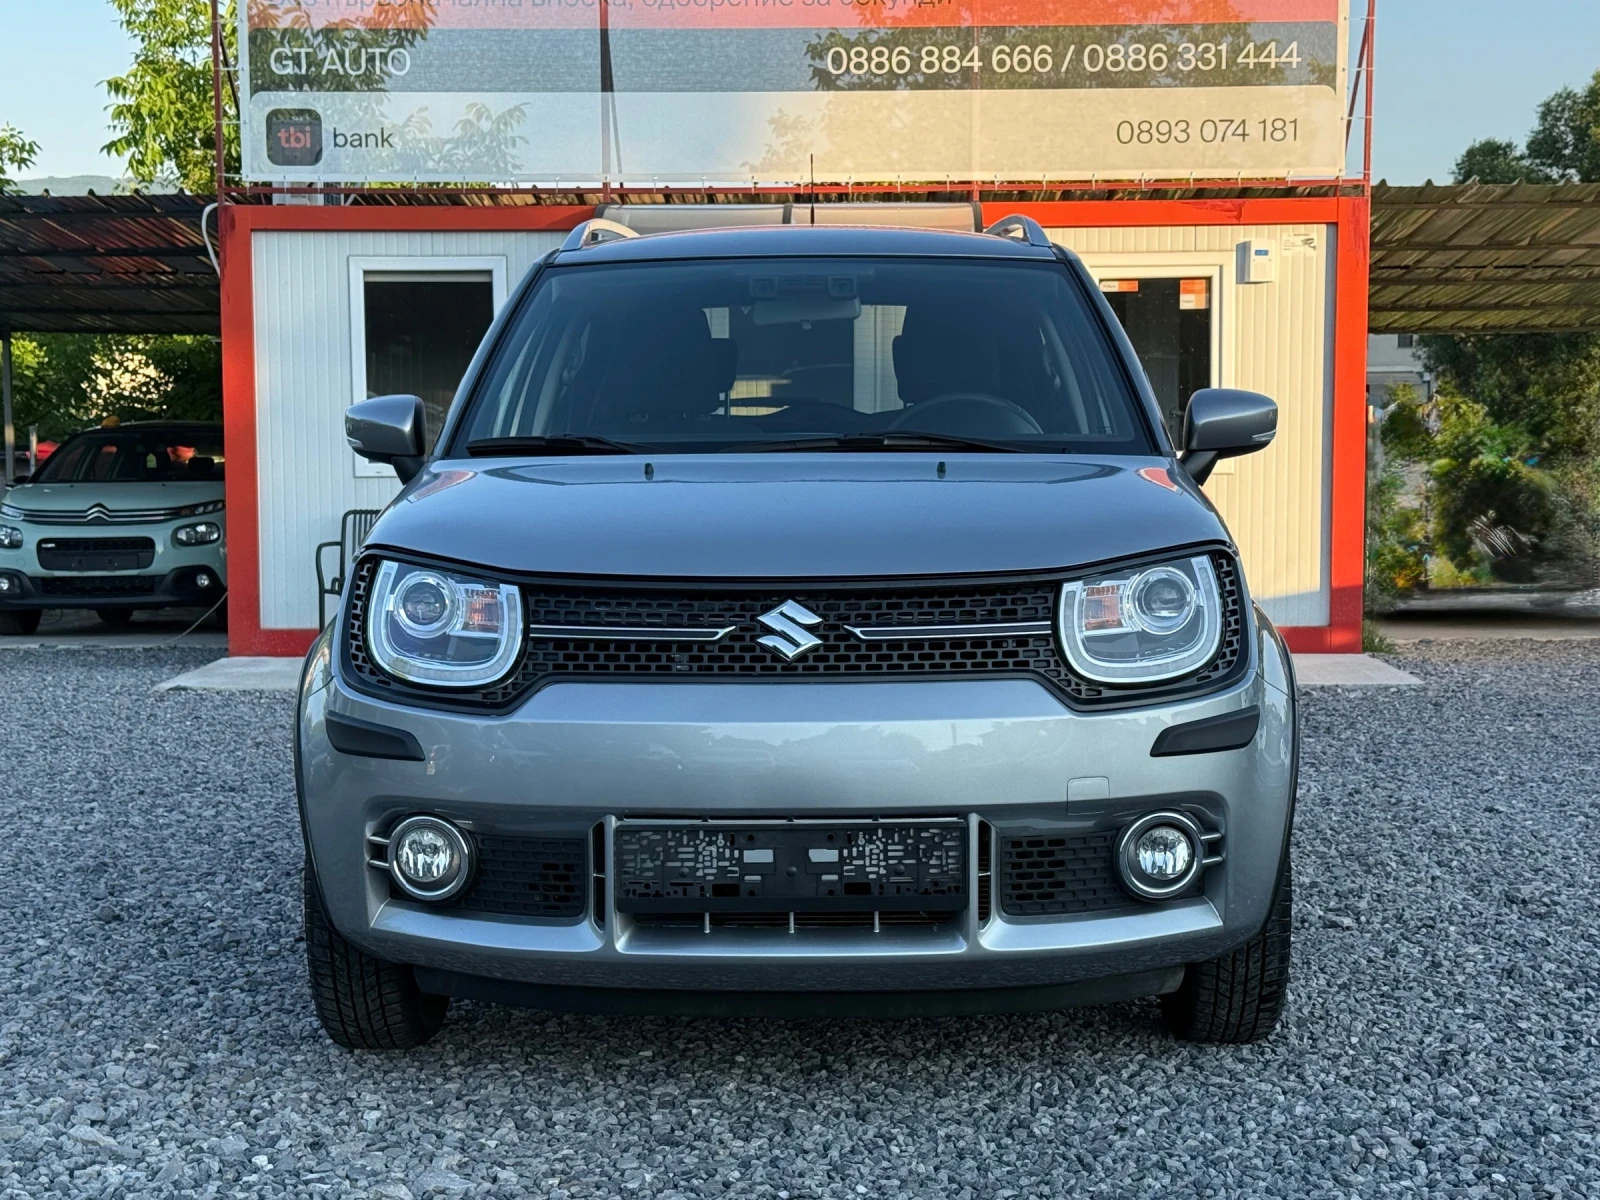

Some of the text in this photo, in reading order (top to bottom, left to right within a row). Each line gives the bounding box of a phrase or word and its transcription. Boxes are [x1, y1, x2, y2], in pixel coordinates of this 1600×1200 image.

[270, 47, 411, 76] GT AUTO
[826, 45, 911, 75] 0886
[919, 45, 983, 74] 884
[991, 44, 1053, 73] 666
[1083, 43, 1168, 72] 0886
[1176, 42, 1228, 71] 331
[1236, 41, 1302, 70] 444
[277, 125, 394, 149] tbi bank
[1116, 117, 1299, 145] 0893 074 181
